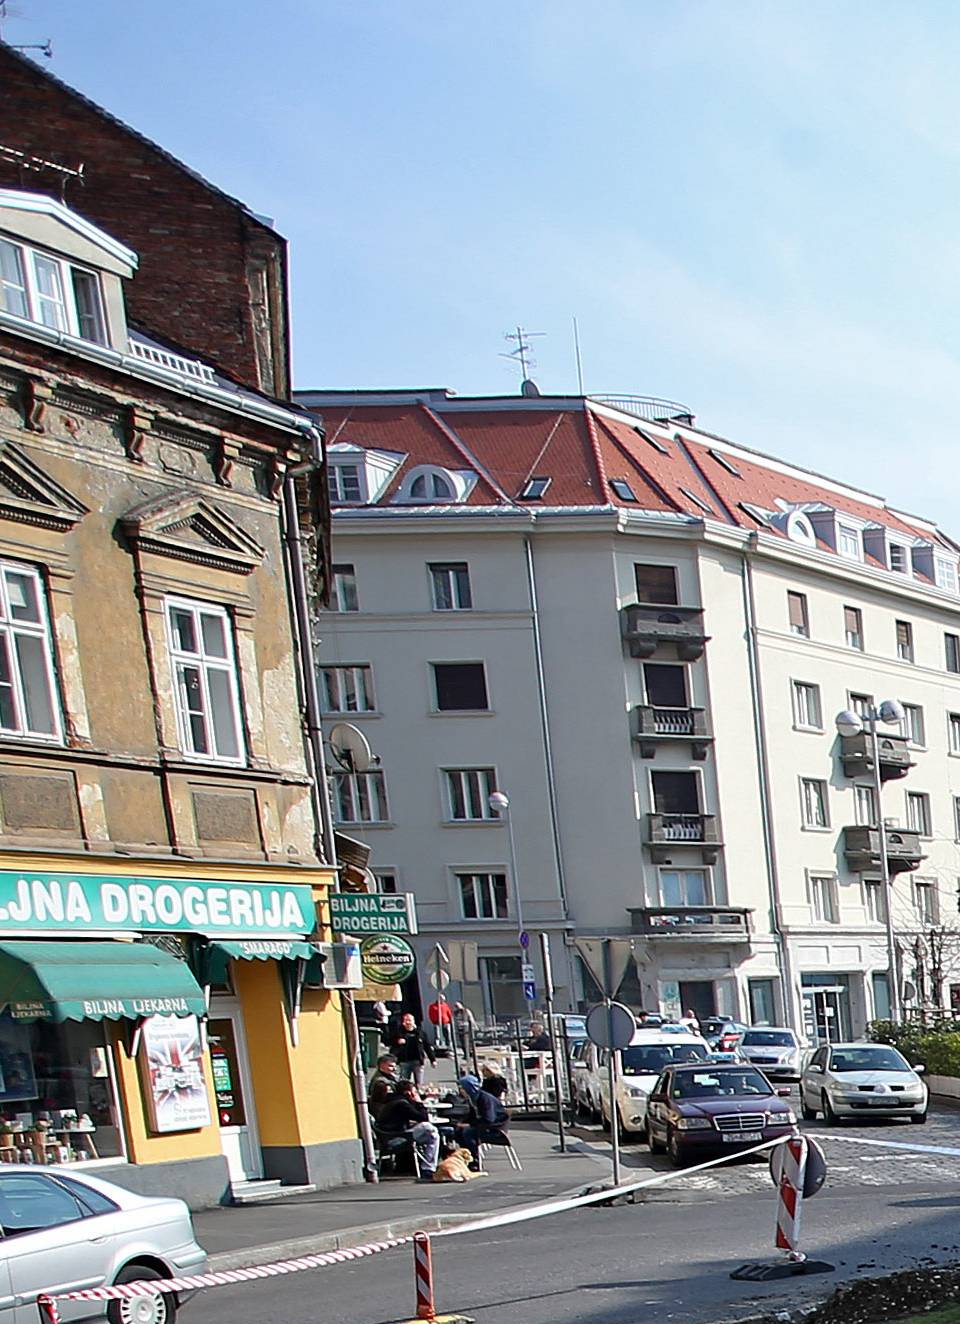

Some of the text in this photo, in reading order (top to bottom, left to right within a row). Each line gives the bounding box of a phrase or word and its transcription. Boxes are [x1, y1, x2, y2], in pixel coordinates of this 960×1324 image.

[100, 883, 305, 927] DROGERIJA
[331, 898, 378, 912] BILJNA
[333, 916, 407, 930] DROGERIJA
[363, 953, 410, 963] Heineken
[83, 999, 188, 1015] BILJNA LJEKARNA
